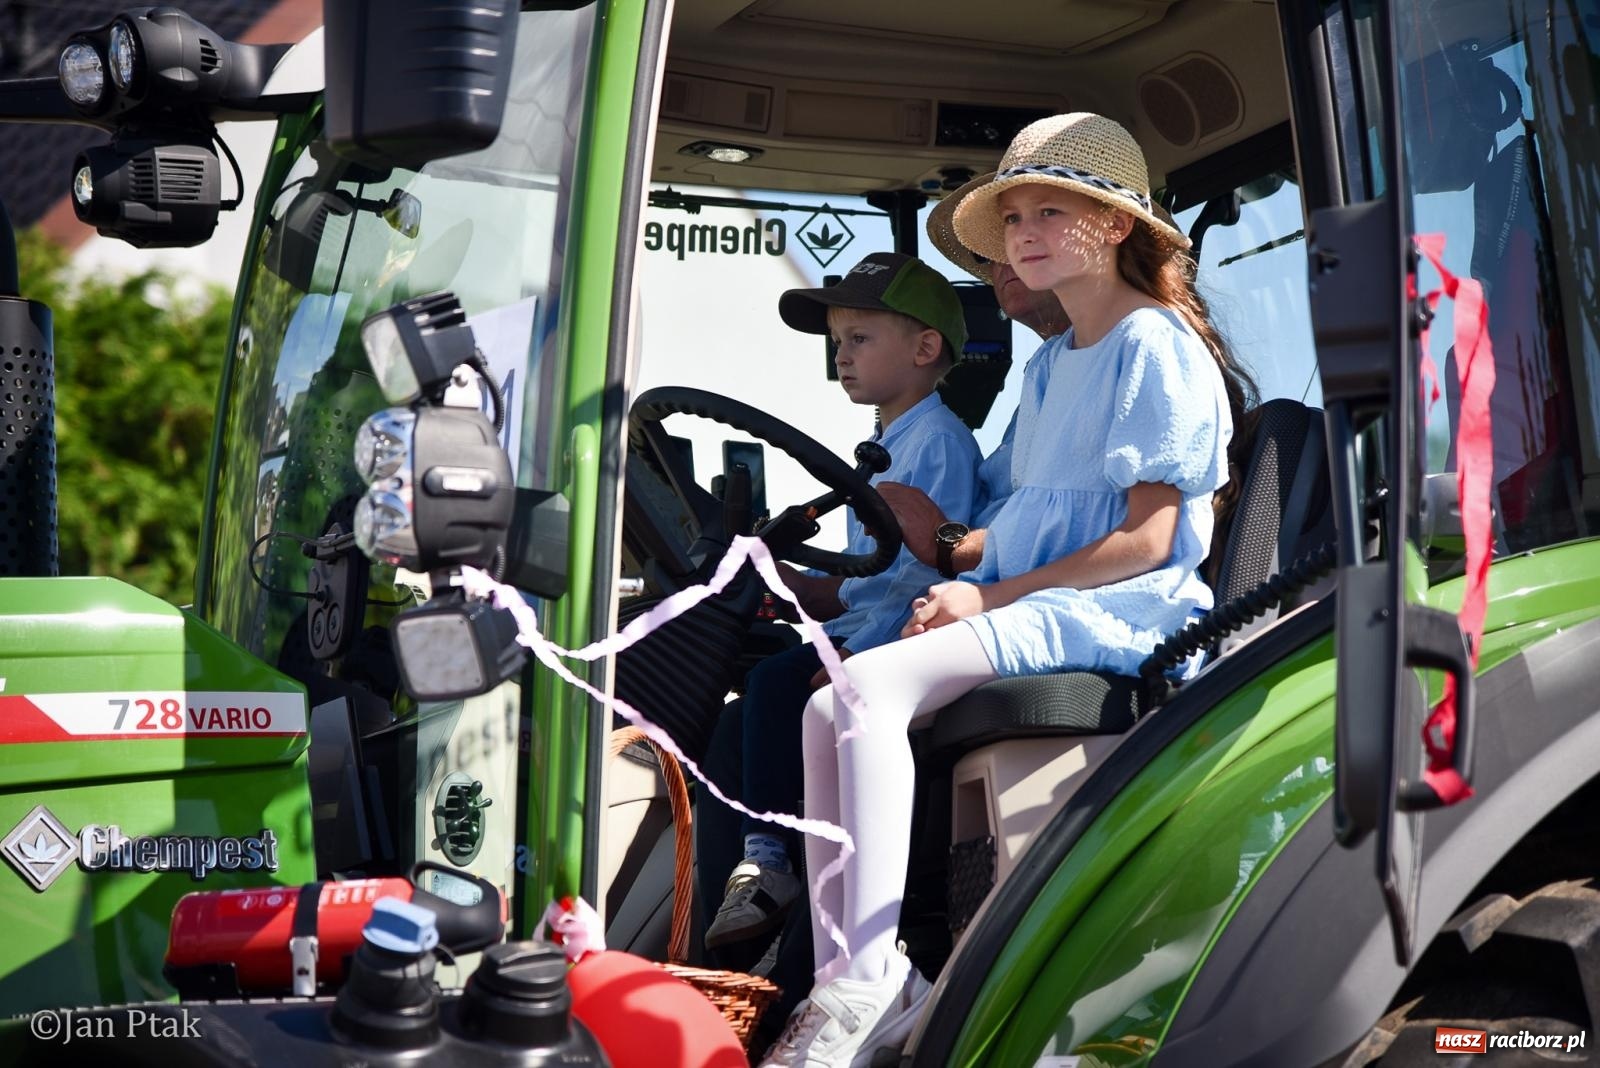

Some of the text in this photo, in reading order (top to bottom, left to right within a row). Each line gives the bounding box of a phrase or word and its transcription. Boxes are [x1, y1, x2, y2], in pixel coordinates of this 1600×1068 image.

[108, 698, 272, 731] 728 VARIO
[78, 824, 280, 880] Chempest
